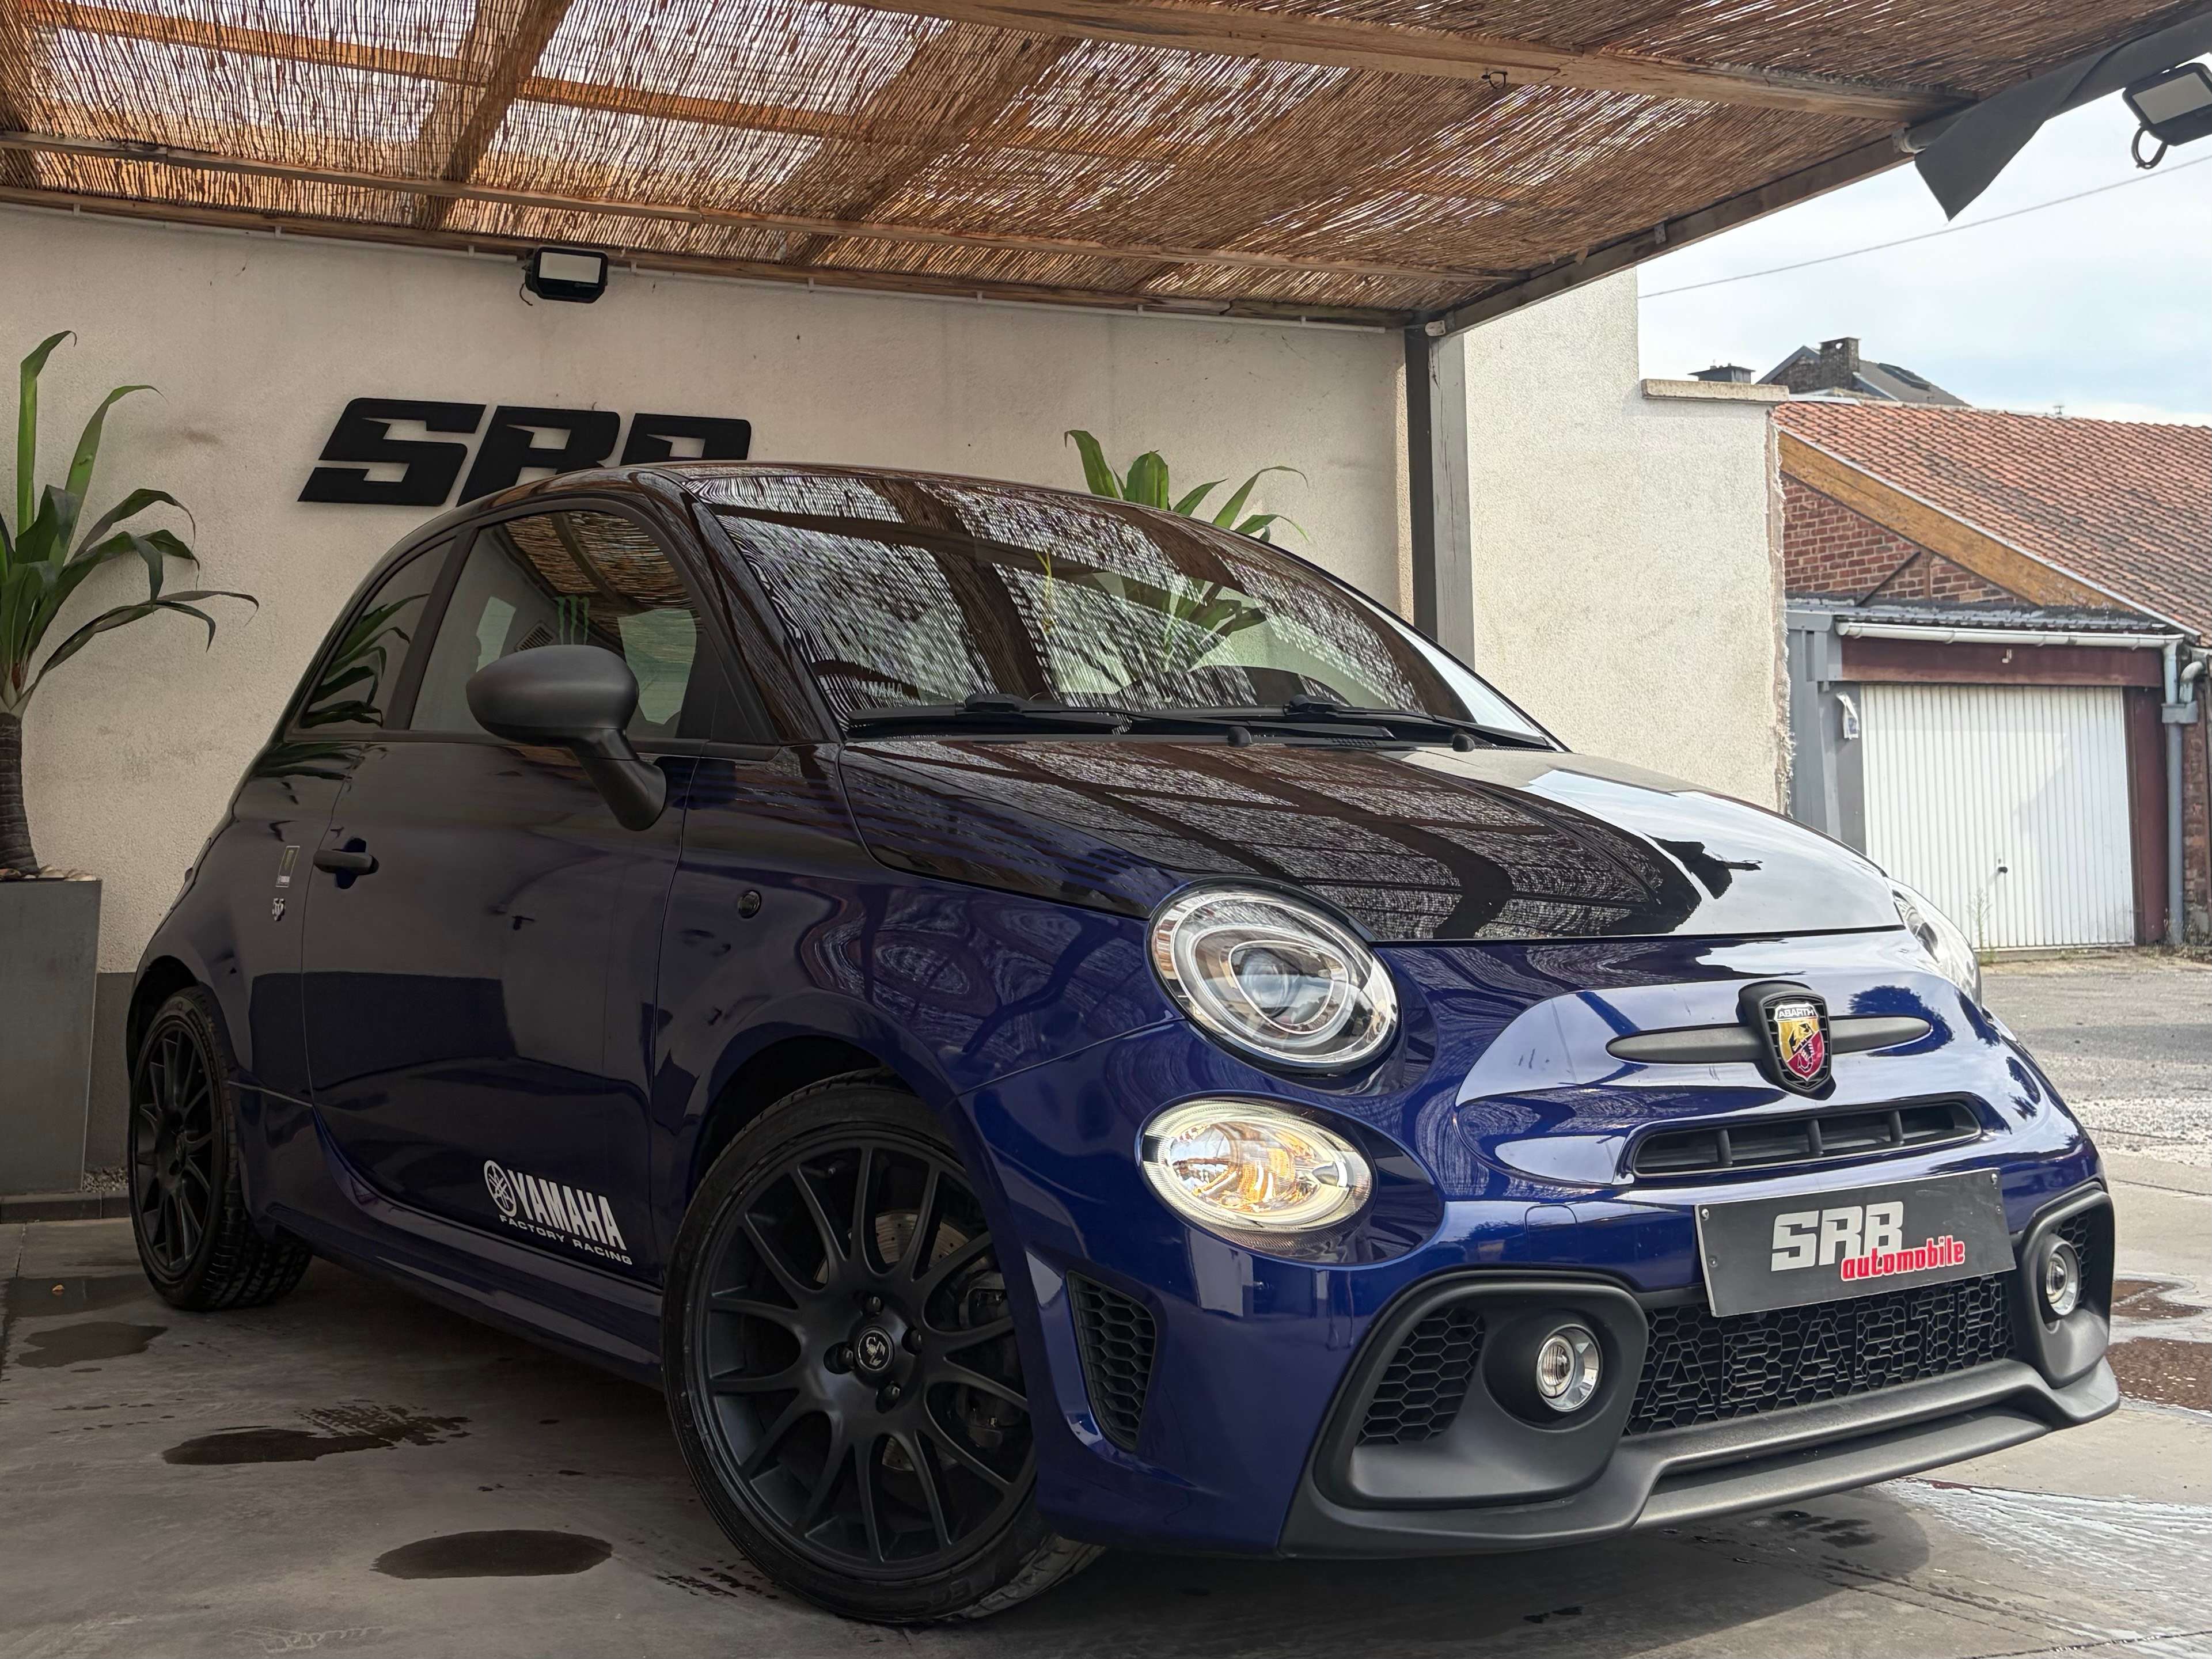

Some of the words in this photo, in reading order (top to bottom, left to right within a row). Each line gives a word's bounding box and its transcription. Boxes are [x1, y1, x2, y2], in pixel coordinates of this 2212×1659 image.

[1779, 1008, 1814, 1018] ABARTH
[499, 1214, 564, 1243] FACTORY
[572, 1239, 632, 1265] RACING
[507, 1169, 627, 1250] YAMAHA
[1771, 1201, 1904, 1271] SRB
[1841, 1235, 1965, 1281] automobile
[1640, 1282, 2003, 1417] ABARTH
